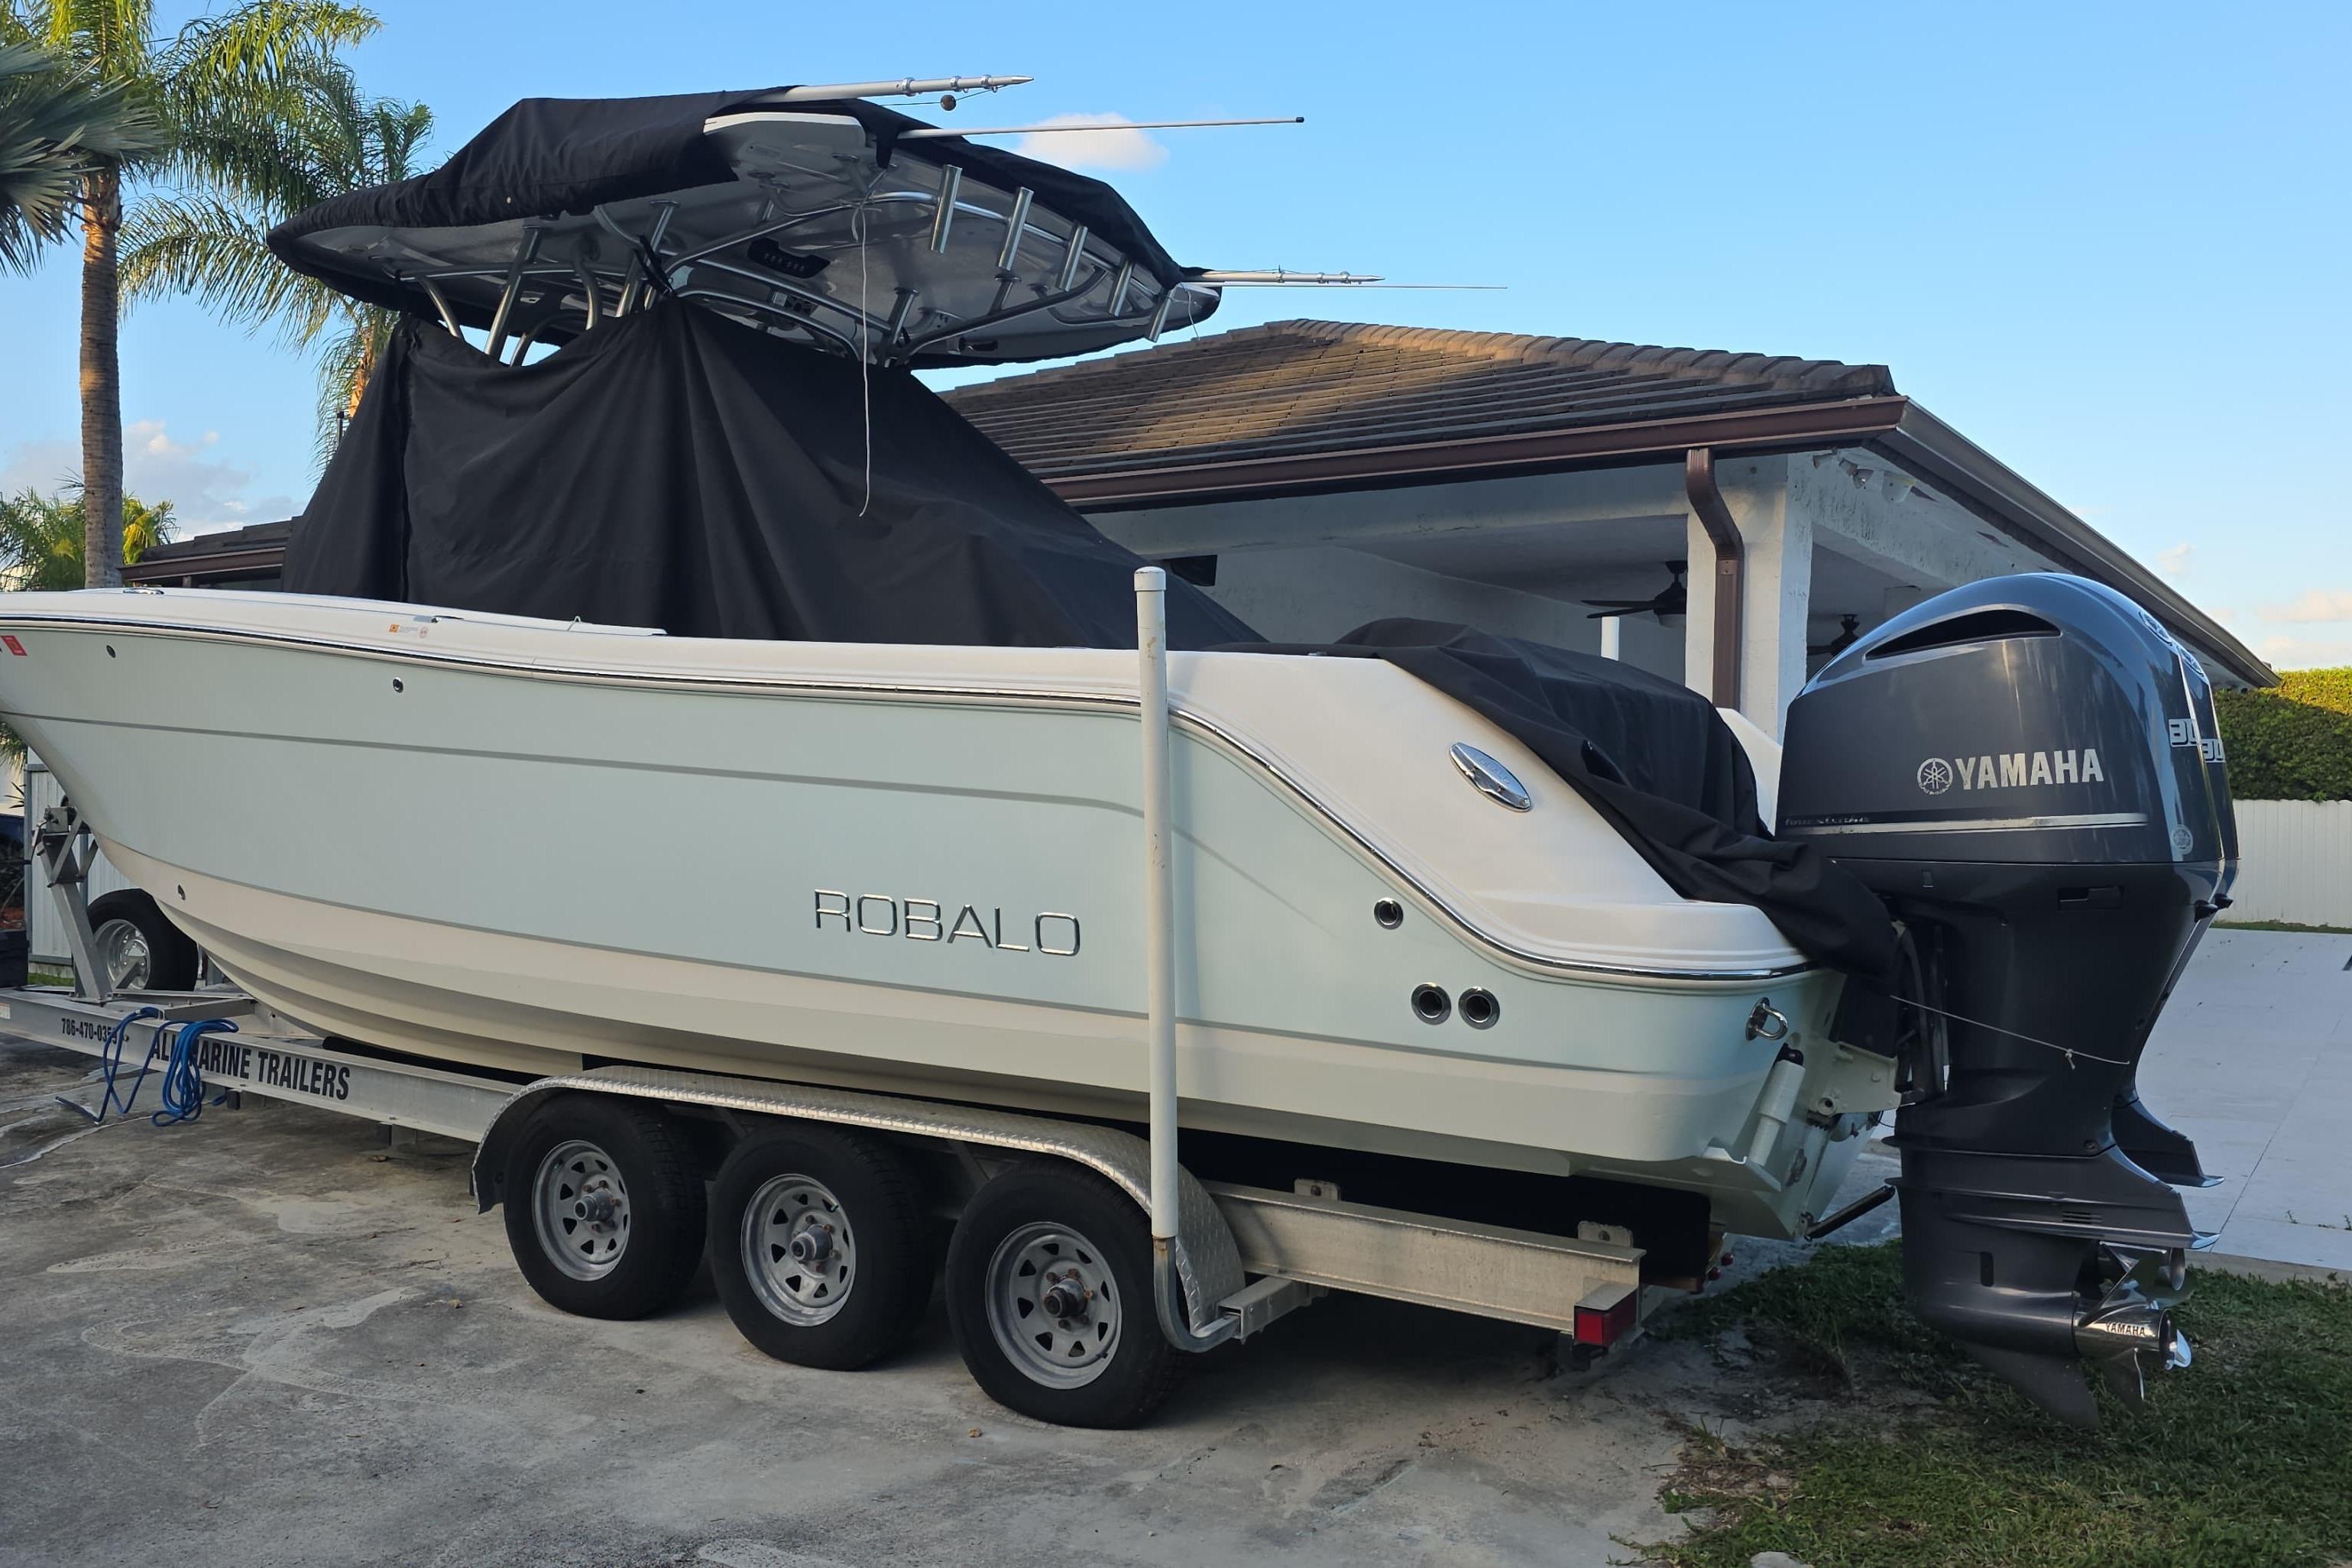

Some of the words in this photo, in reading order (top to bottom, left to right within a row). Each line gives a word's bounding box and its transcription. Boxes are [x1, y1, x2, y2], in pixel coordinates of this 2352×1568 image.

[1955, 748, 2104, 790] YAMAHA
[815, 889, 1080, 956] ROBALO
[258, 1051, 350, 1100] TRAILERS
[2105, 1322, 2146, 1337] YAMAHA
